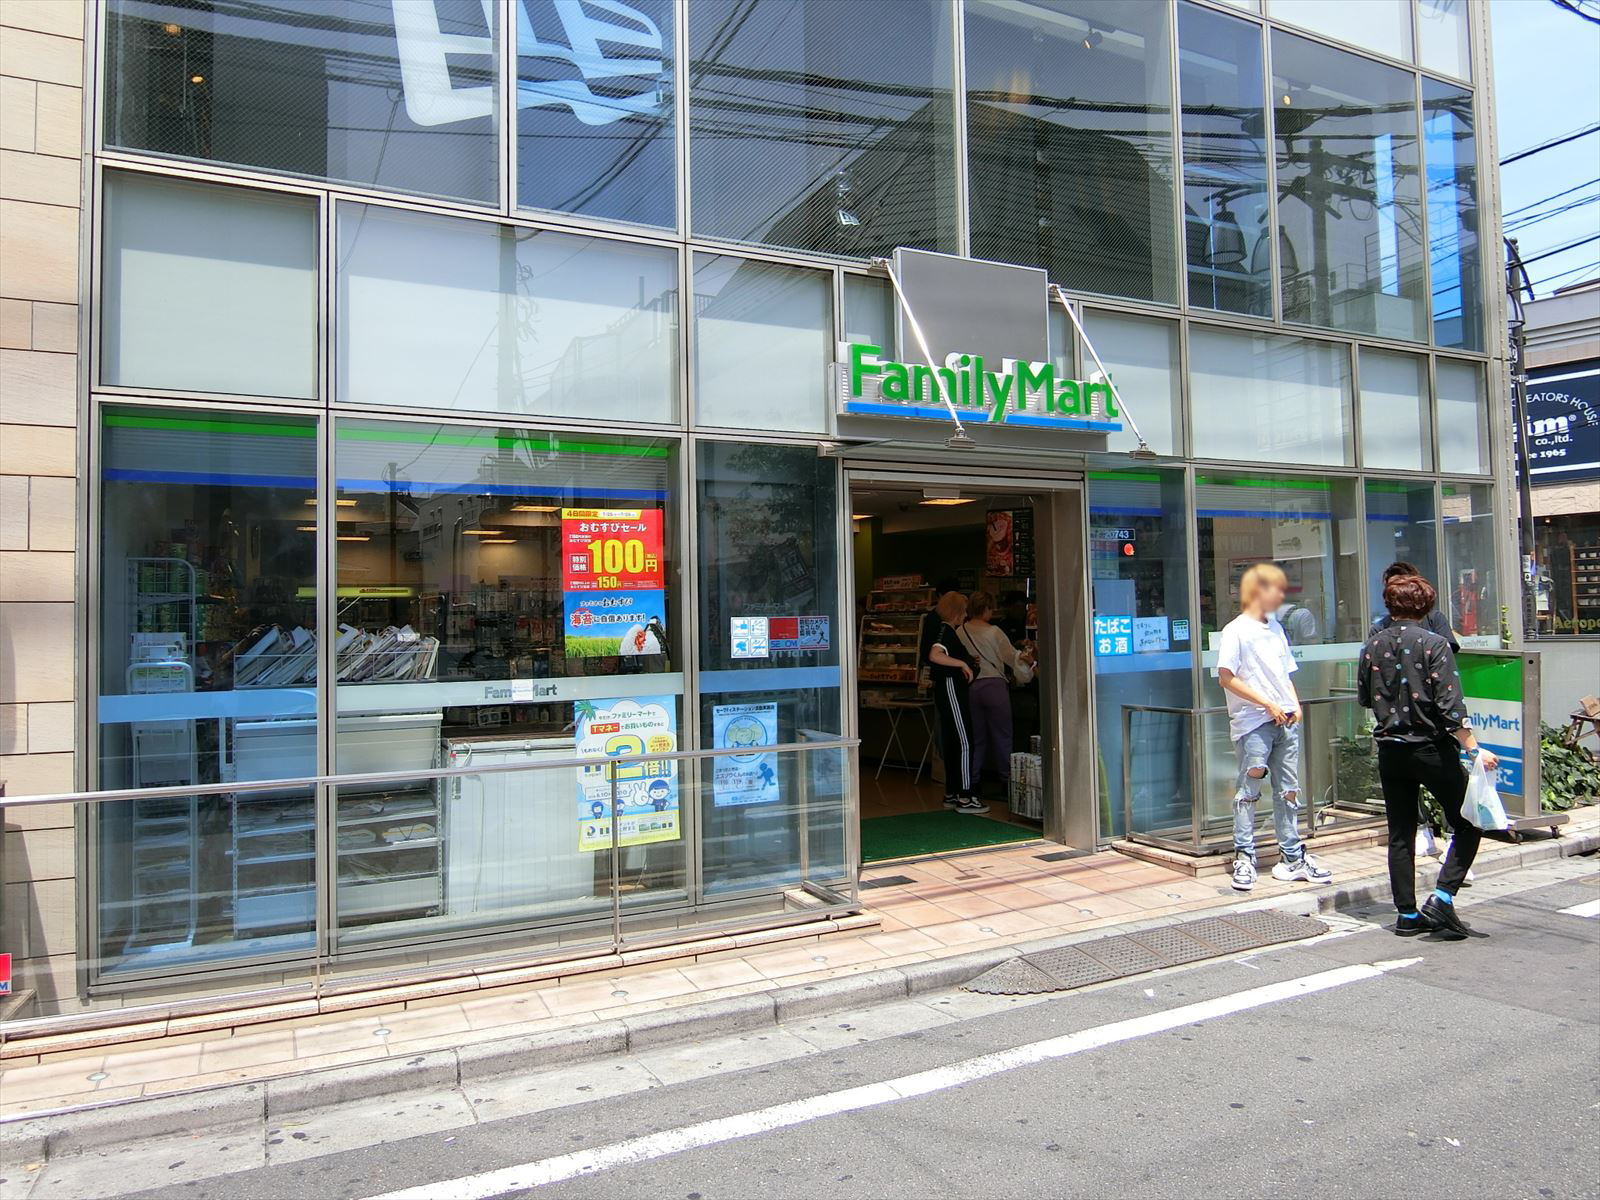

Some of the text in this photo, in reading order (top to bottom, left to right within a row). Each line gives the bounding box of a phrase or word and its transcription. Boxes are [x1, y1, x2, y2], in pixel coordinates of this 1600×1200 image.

[849, 343, 1119, 423] FamilyMart
[1526, 392, 1570, 404] EATORS
[1526, 416, 1570, 437] im
[579, 522, 648, 533] おむすびセール
[1094, 618, 1132, 635] たばこ
[771, 640, 798, 648] SEOM
[1098, 637, 1129, 654] お酒
[484, 684, 558, 699] Famart
[591, 724, 619, 733] Tマネー
[1469, 712, 1520, 732] ilyMart
